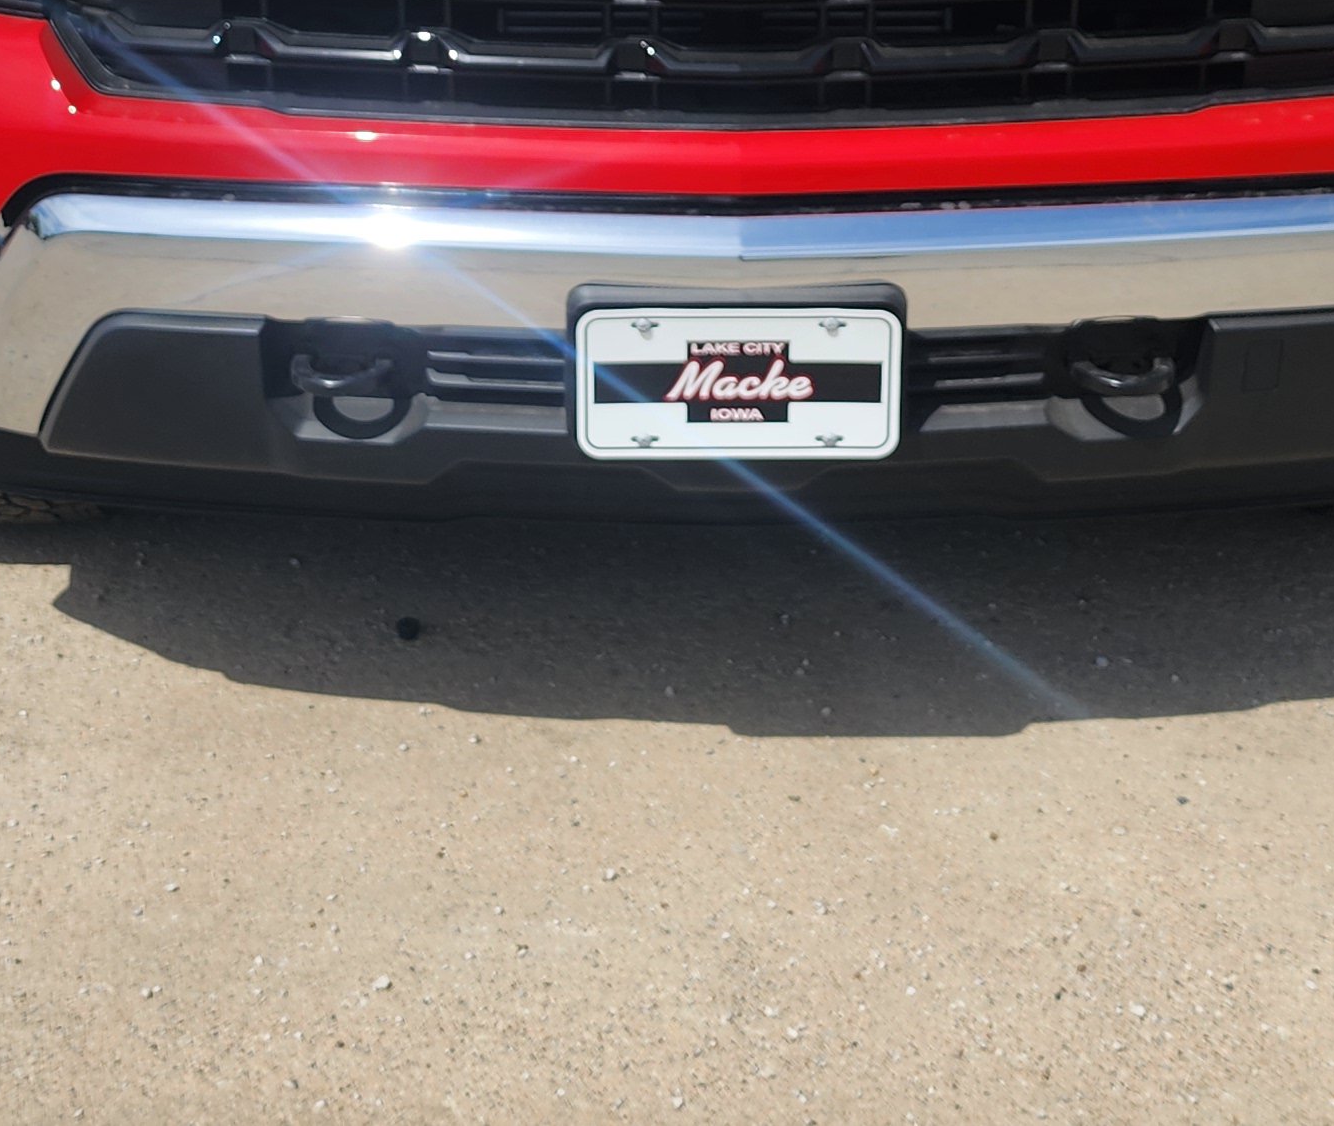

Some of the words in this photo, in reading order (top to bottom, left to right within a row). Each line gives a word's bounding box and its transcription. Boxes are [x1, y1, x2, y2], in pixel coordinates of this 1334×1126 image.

[690, 342, 740, 355] LAKE
[742, 342, 785, 355] CITY
[665, 358, 814, 401] Macke
[710, 407, 764, 421] IOWA
